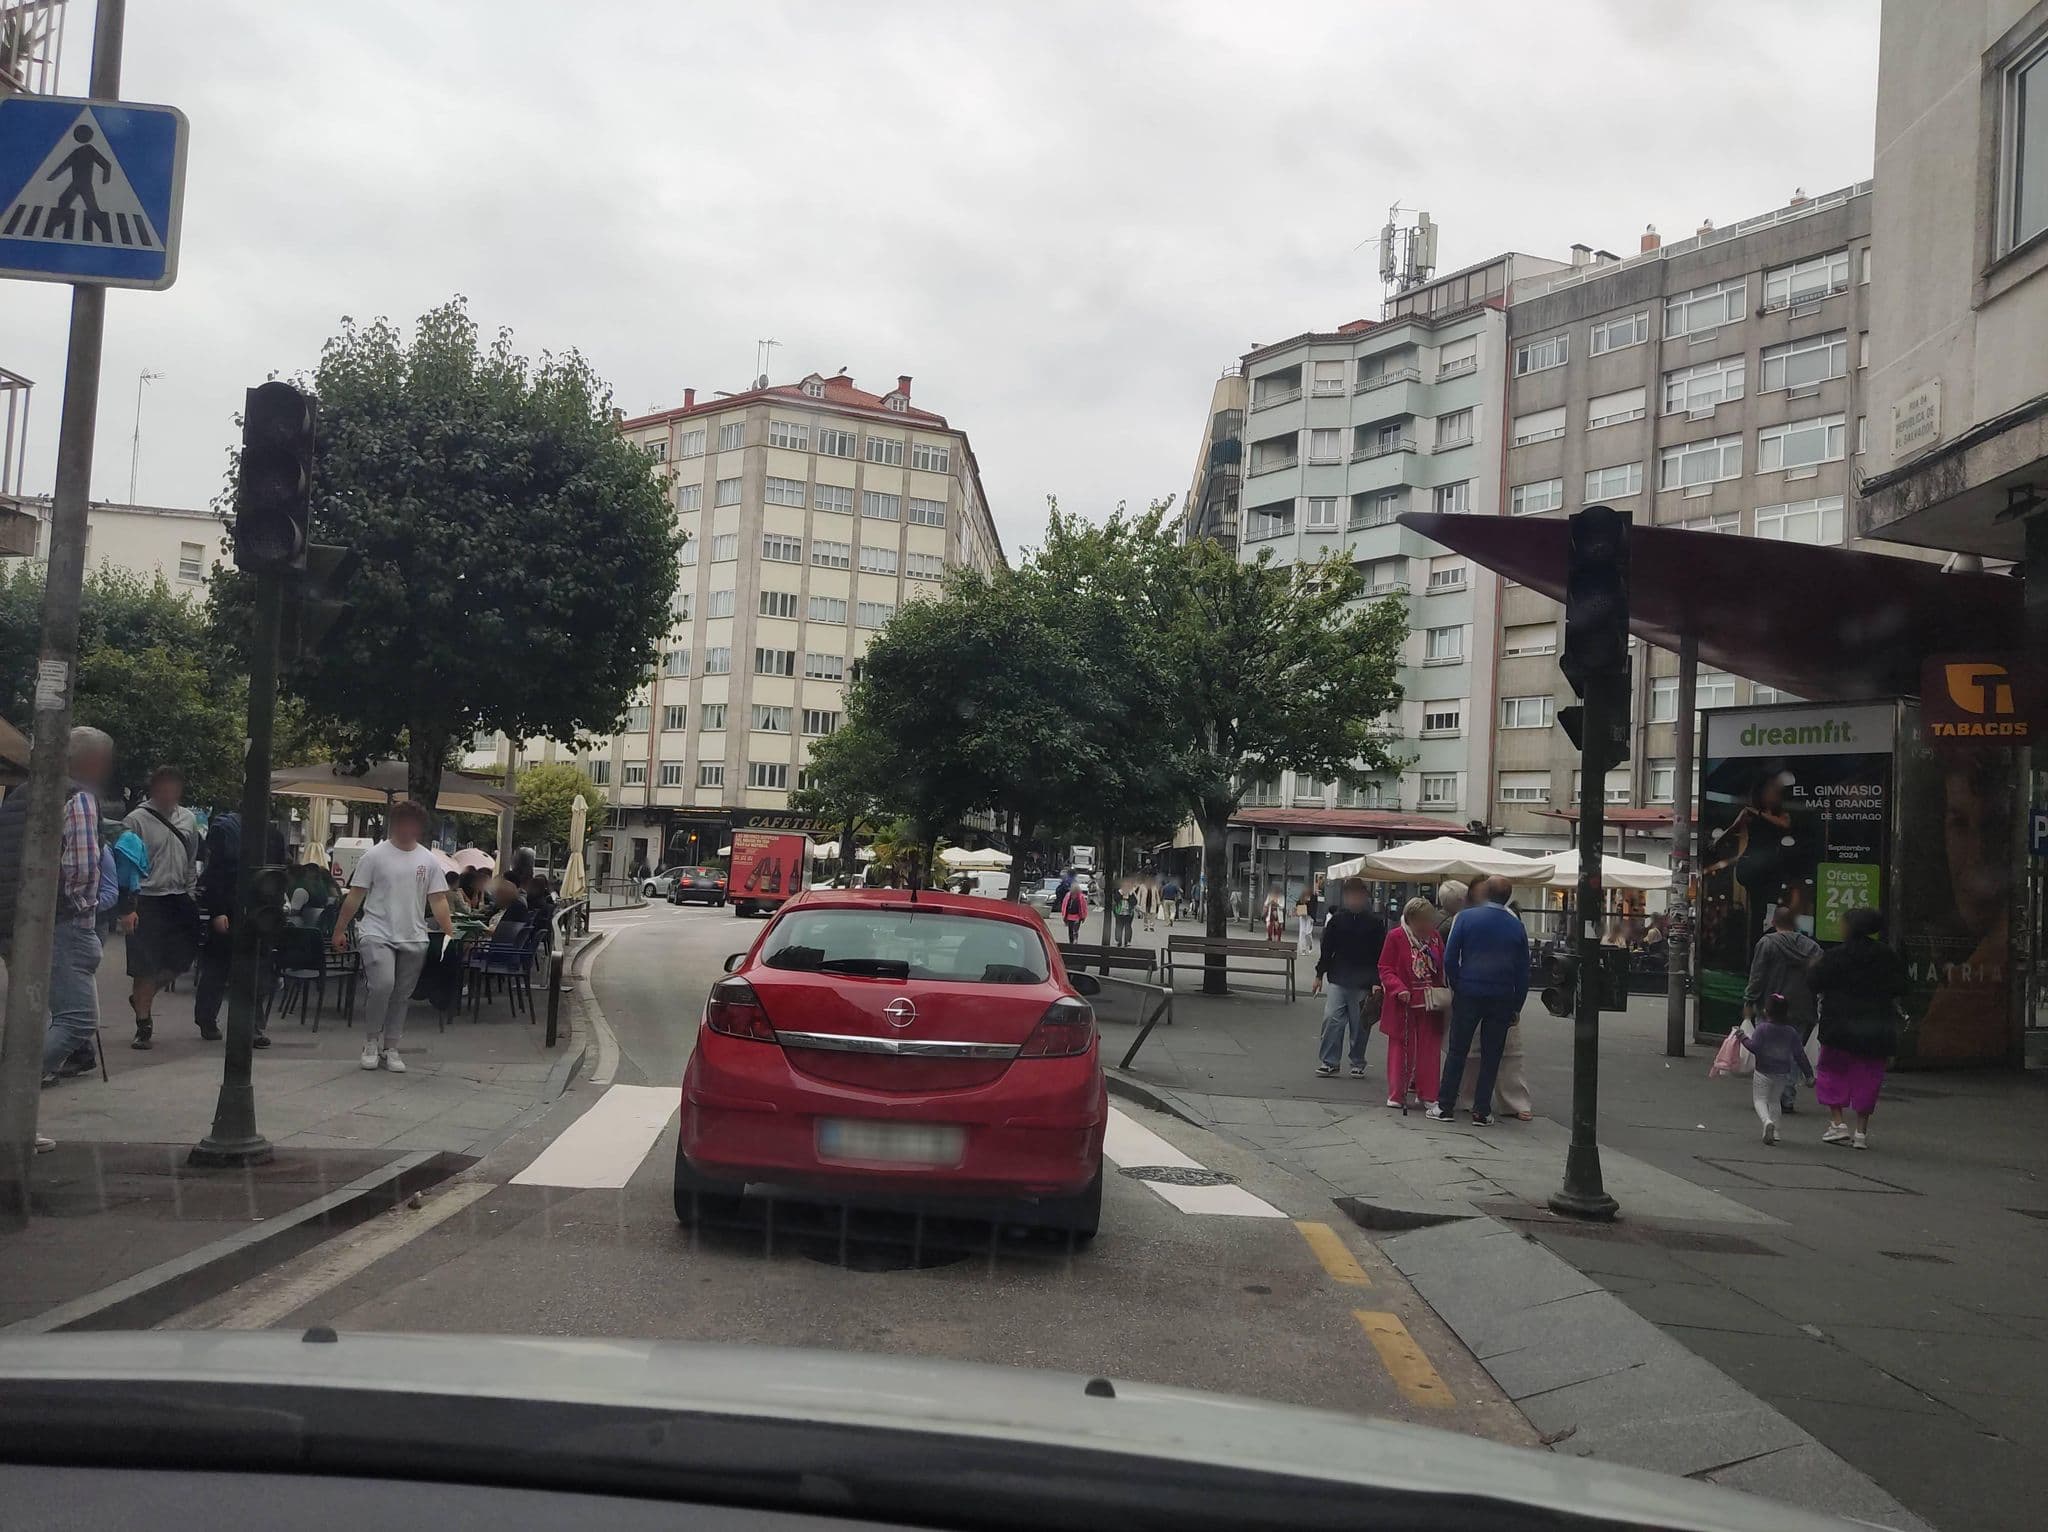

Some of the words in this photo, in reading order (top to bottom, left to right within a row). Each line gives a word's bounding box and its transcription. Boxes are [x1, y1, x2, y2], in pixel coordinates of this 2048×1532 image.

[1740, 719, 1852, 746] dreamfit
[1931, 722, 2029, 736] TABACOS
[1792, 786, 1808, 797] EL
[1815, 785, 1882, 796] GIMNASIO
[1805, 798, 1830, 808] MÁS
[1835, 799, 1882, 808] GRANDE
[1835, 813, 1882, 821] SANTIAGO
[1828, 844, 1870, 852] Septiembre
[1826, 870, 1868, 881] Oferta
